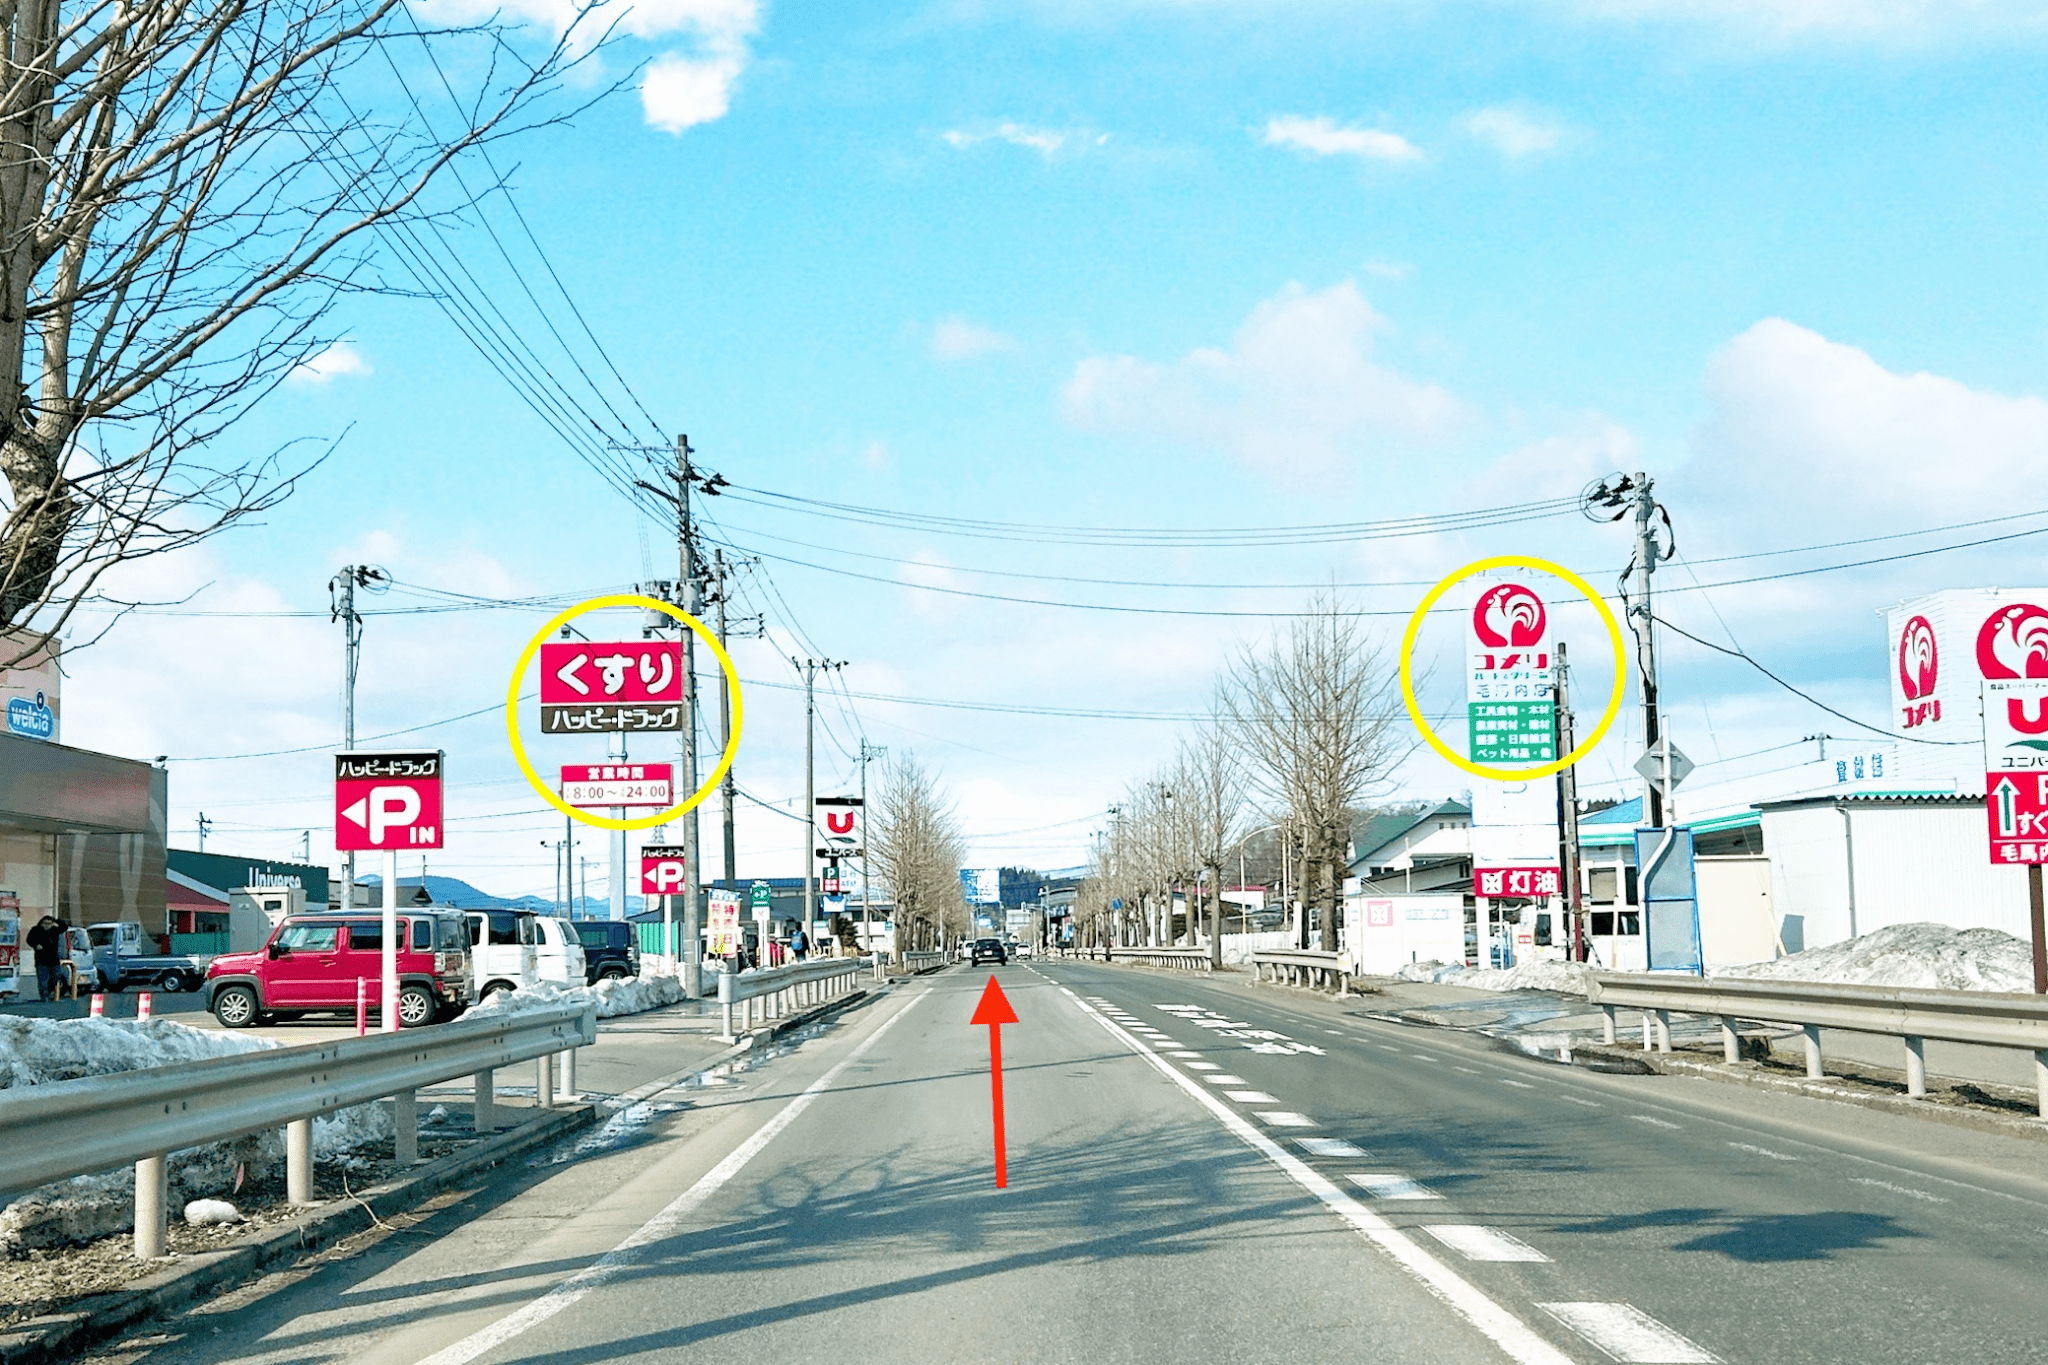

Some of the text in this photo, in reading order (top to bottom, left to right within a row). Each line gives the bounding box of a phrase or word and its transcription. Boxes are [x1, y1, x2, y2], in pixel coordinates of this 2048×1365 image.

[557, 653, 673, 695] くすり
[1474, 654, 1547, 670] コメリ
[1902, 699, 1941, 729] コメリ
[369, 785, 422, 845] P
[409, 826, 435, 844] IN
[658, 861, 684, 892] P
[827, 867, 836, 878] P
[1509, 870, 1558, 894] 灯油
